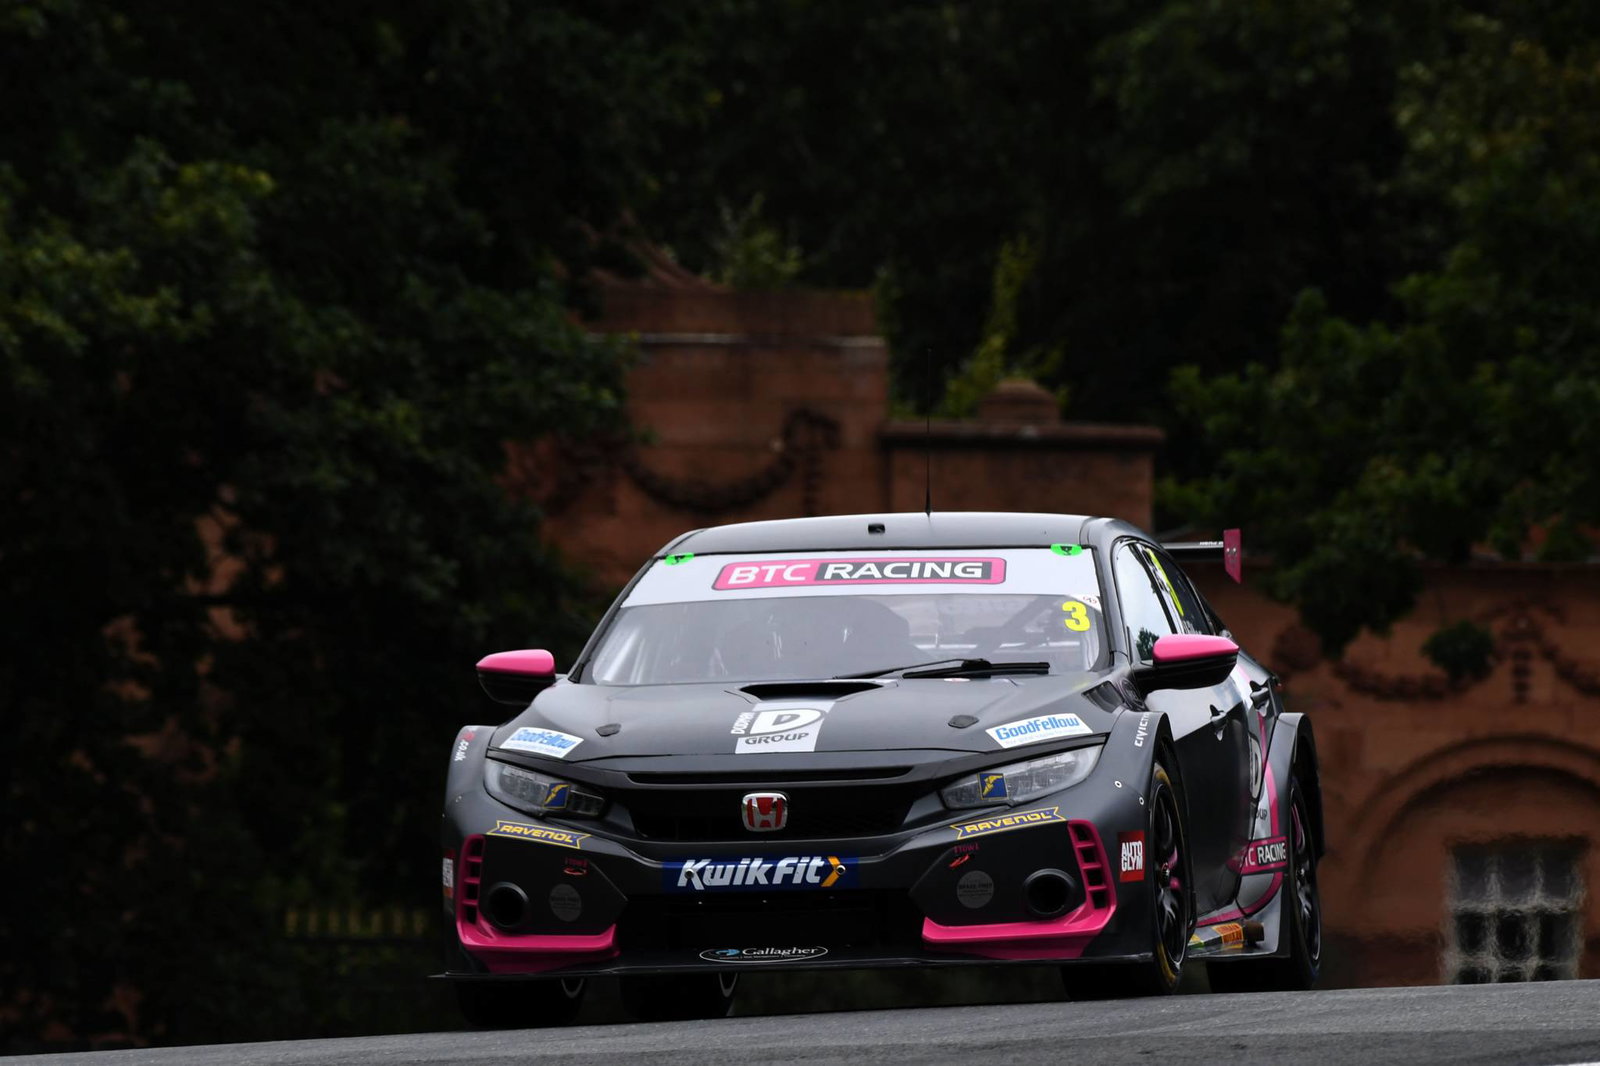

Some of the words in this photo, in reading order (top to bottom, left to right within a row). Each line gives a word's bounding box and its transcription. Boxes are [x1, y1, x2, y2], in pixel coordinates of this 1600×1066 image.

[728, 564, 806, 584] BTC
[823, 561, 984, 581] RACING
[1062, 601, 1091, 632] 3
[745, 732, 809, 745] GROUP
[965, 811, 1051, 834] RAVENOL
[500, 824, 574, 843] RAVENOL
[1121, 841, 1143, 858] AUTO
[1257, 842, 1287, 865] RACING
[1121, 855, 1143, 872] GLYM
[742, 946, 818, 956] Gallagher
